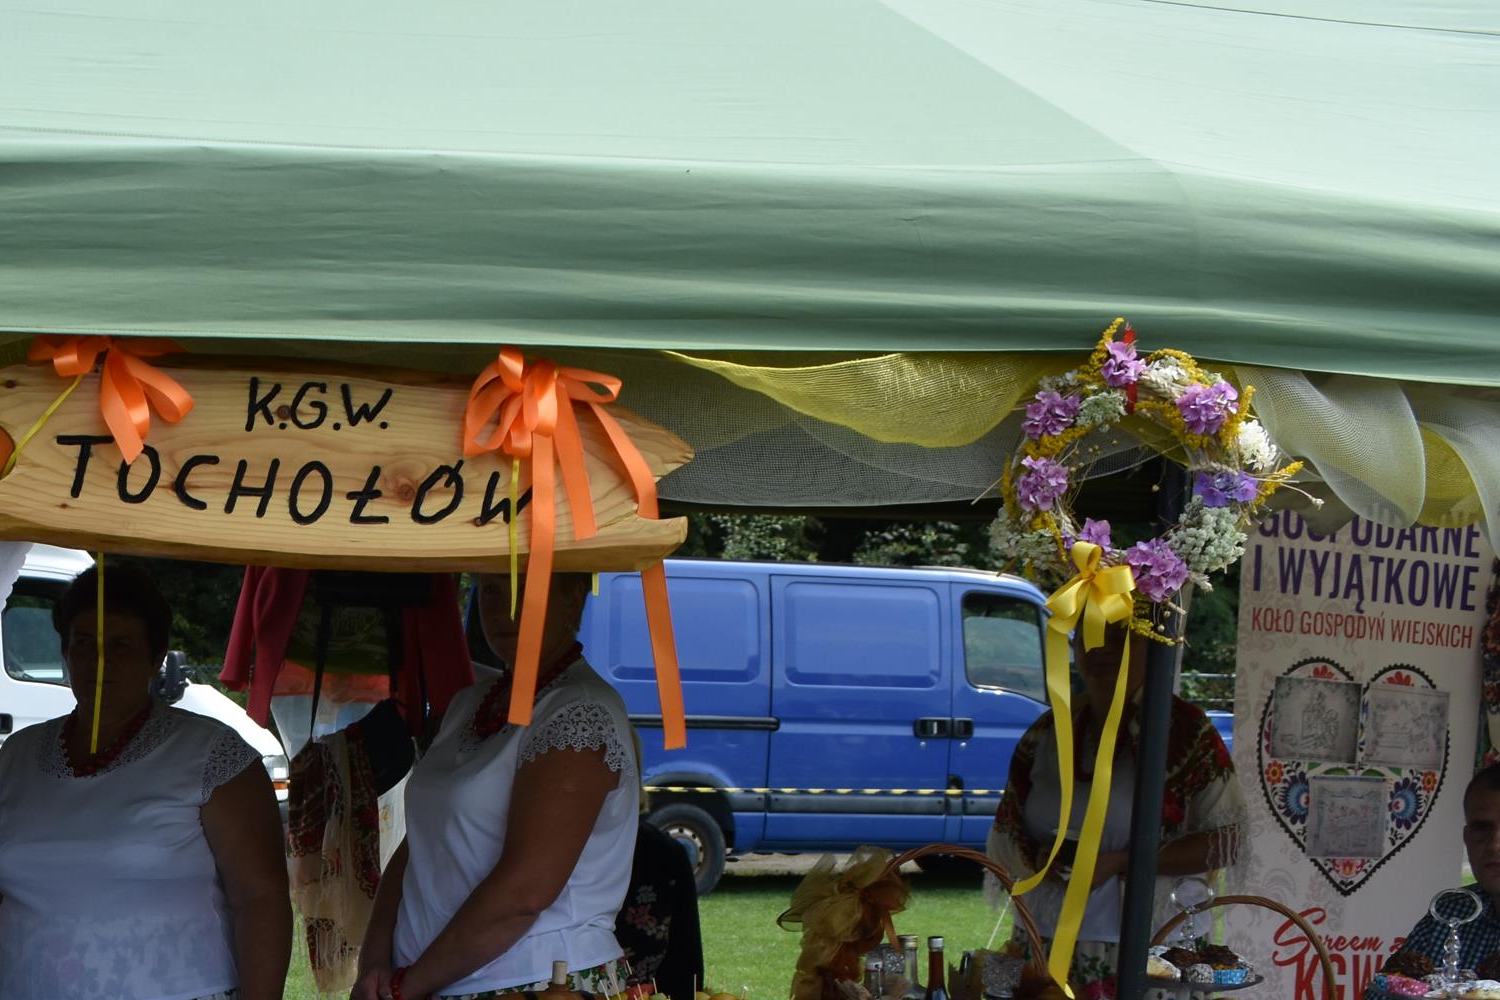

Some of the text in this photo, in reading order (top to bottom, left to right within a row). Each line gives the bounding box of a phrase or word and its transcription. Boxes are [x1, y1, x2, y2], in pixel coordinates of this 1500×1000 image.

[244, 376, 394, 432] K.G.W.
[56, 434, 534, 525] TOCHOŁÓW
[1252, 544, 1481, 614] I WYJĄTKOWE
[1252, 607, 1474, 649] KOŁO GOSPODYŃ WIEJSKICH
[1272, 907, 1384, 967] Srcem
